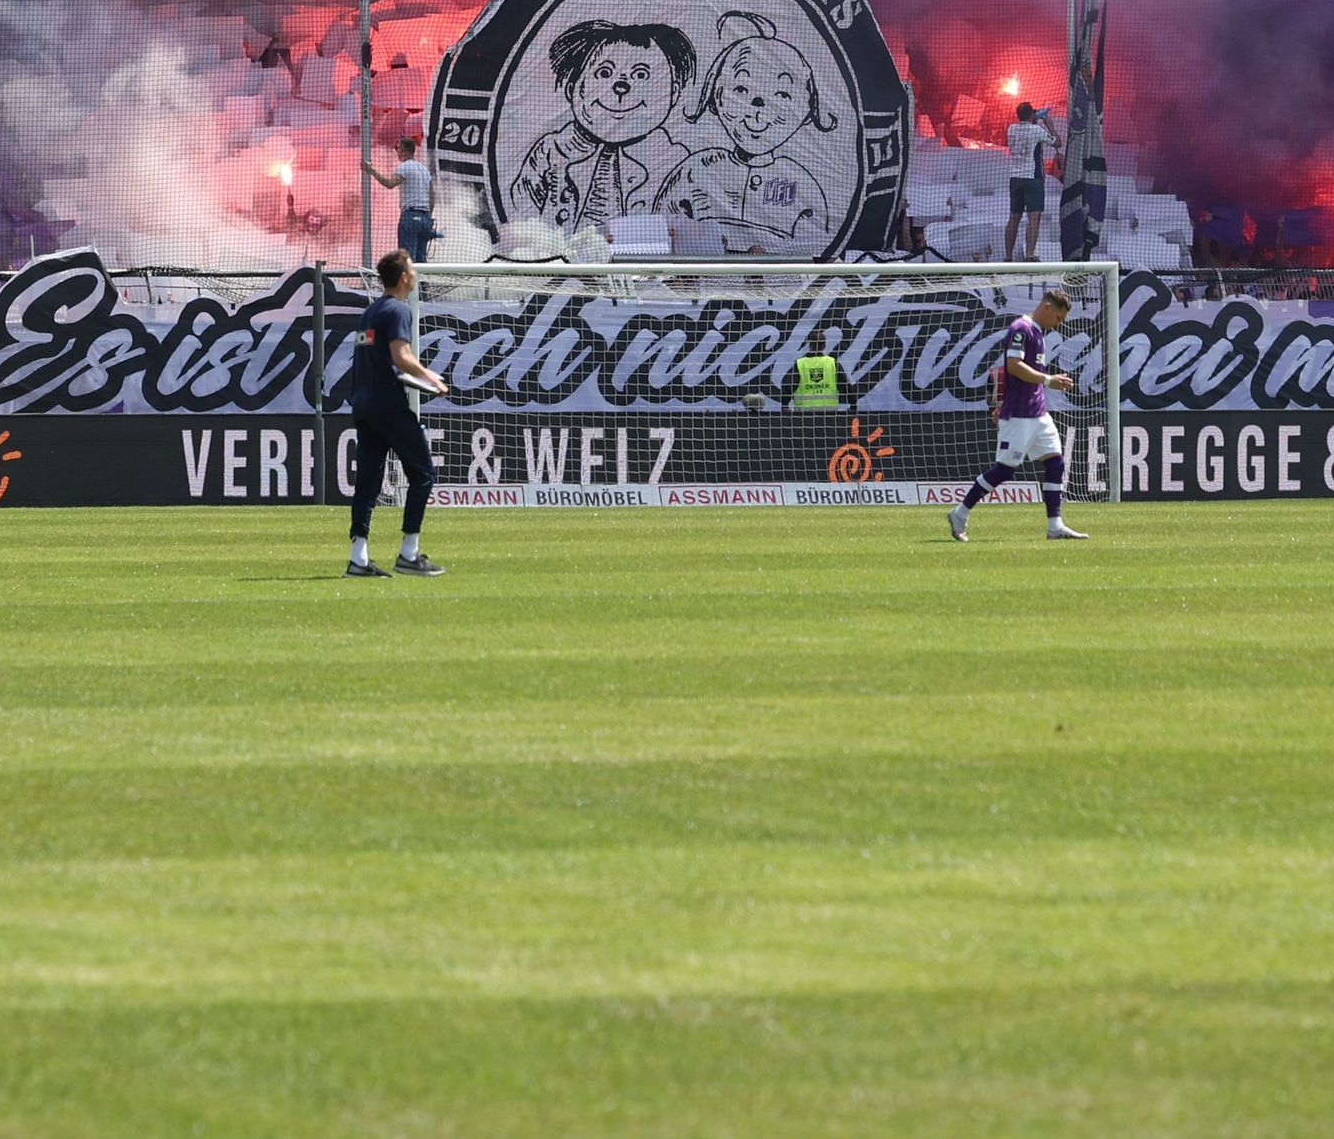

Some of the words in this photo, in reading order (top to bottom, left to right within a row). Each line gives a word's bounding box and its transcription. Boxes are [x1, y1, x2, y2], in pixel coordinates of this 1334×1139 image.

[441, 121, 481, 147] 20
[157, 276, 365, 400] ist
[425, 490, 517, 506] SSMANN
[535, 488, 649, 507] BÜROMÖBEL
[668, 489, 777, 505] ASSMANN
[795, 487, 907, 505] BÜROMÖBEL
[924, 486, 1034, 504] ASSANN
